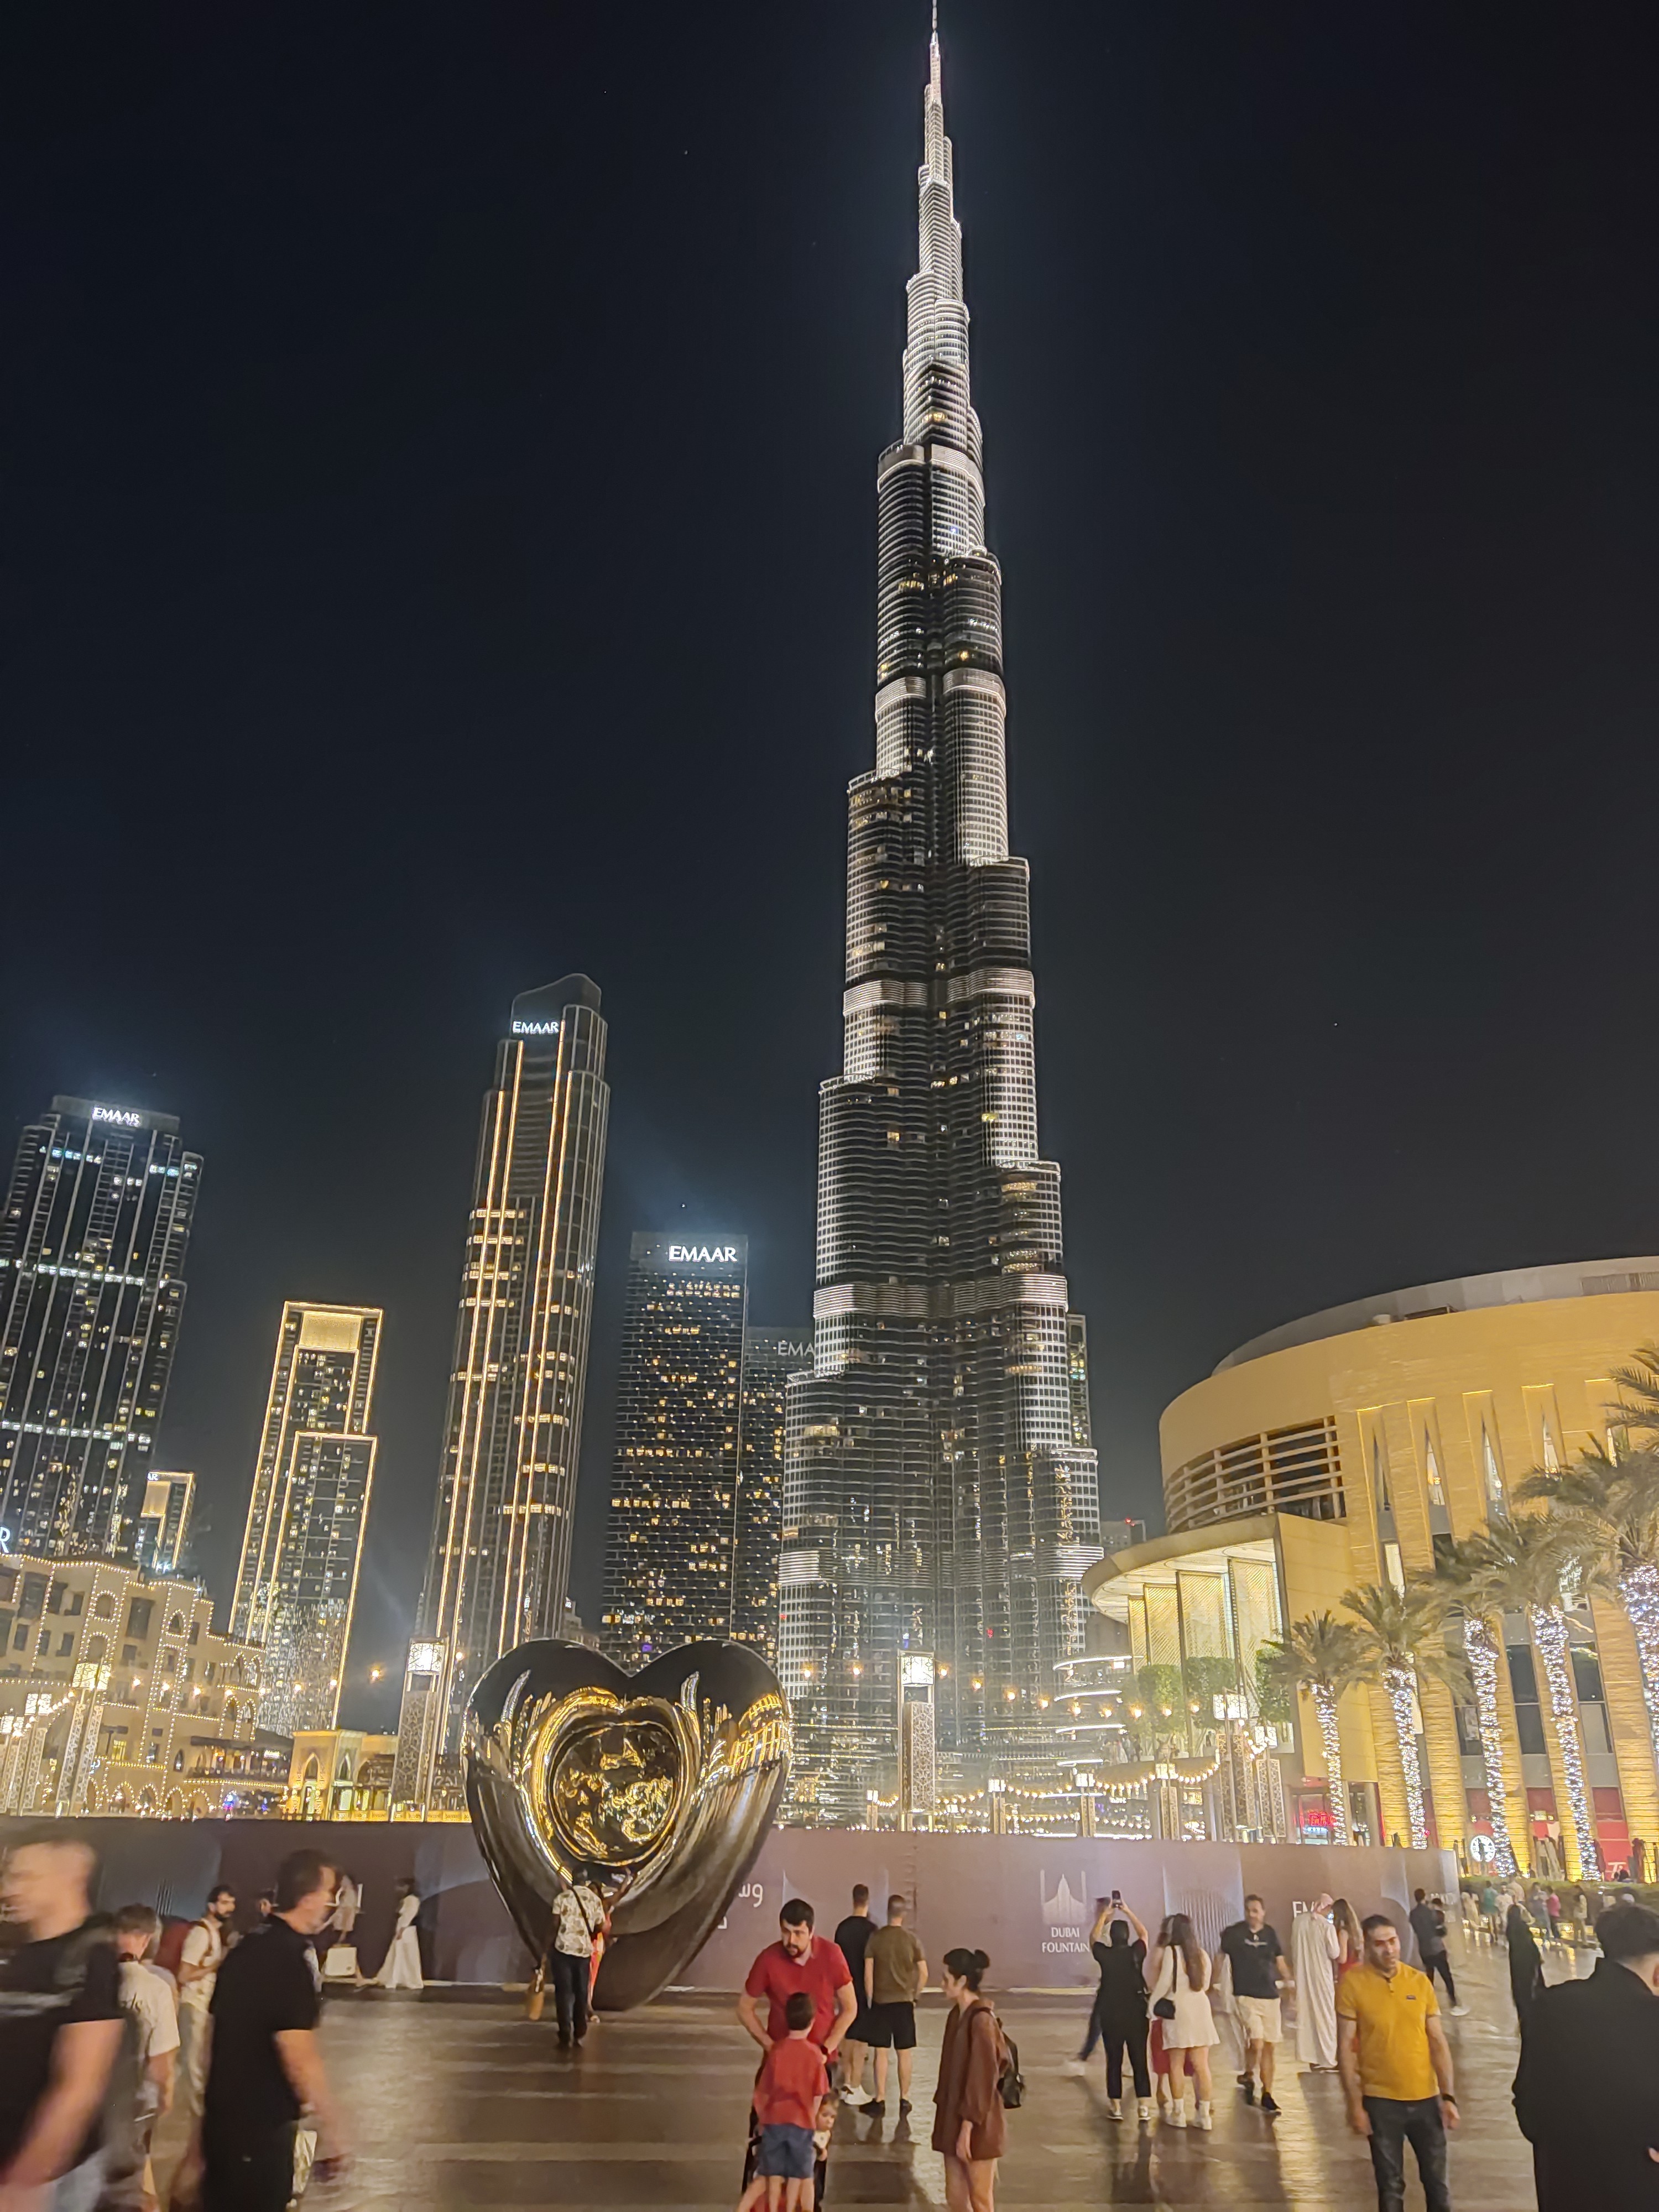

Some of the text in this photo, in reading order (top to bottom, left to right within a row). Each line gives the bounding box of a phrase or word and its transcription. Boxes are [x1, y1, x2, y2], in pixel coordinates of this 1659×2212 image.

[513, 1021, 559, 1034] EMAAR
[92, 1107, 141, 1127] EMAAR
[669, 1245, 738, 1262] EMAAR
[1051, 1927, 1079, 1938] DUBAI
[1042, 1942, 1090, 1953] FOUNTAIN
